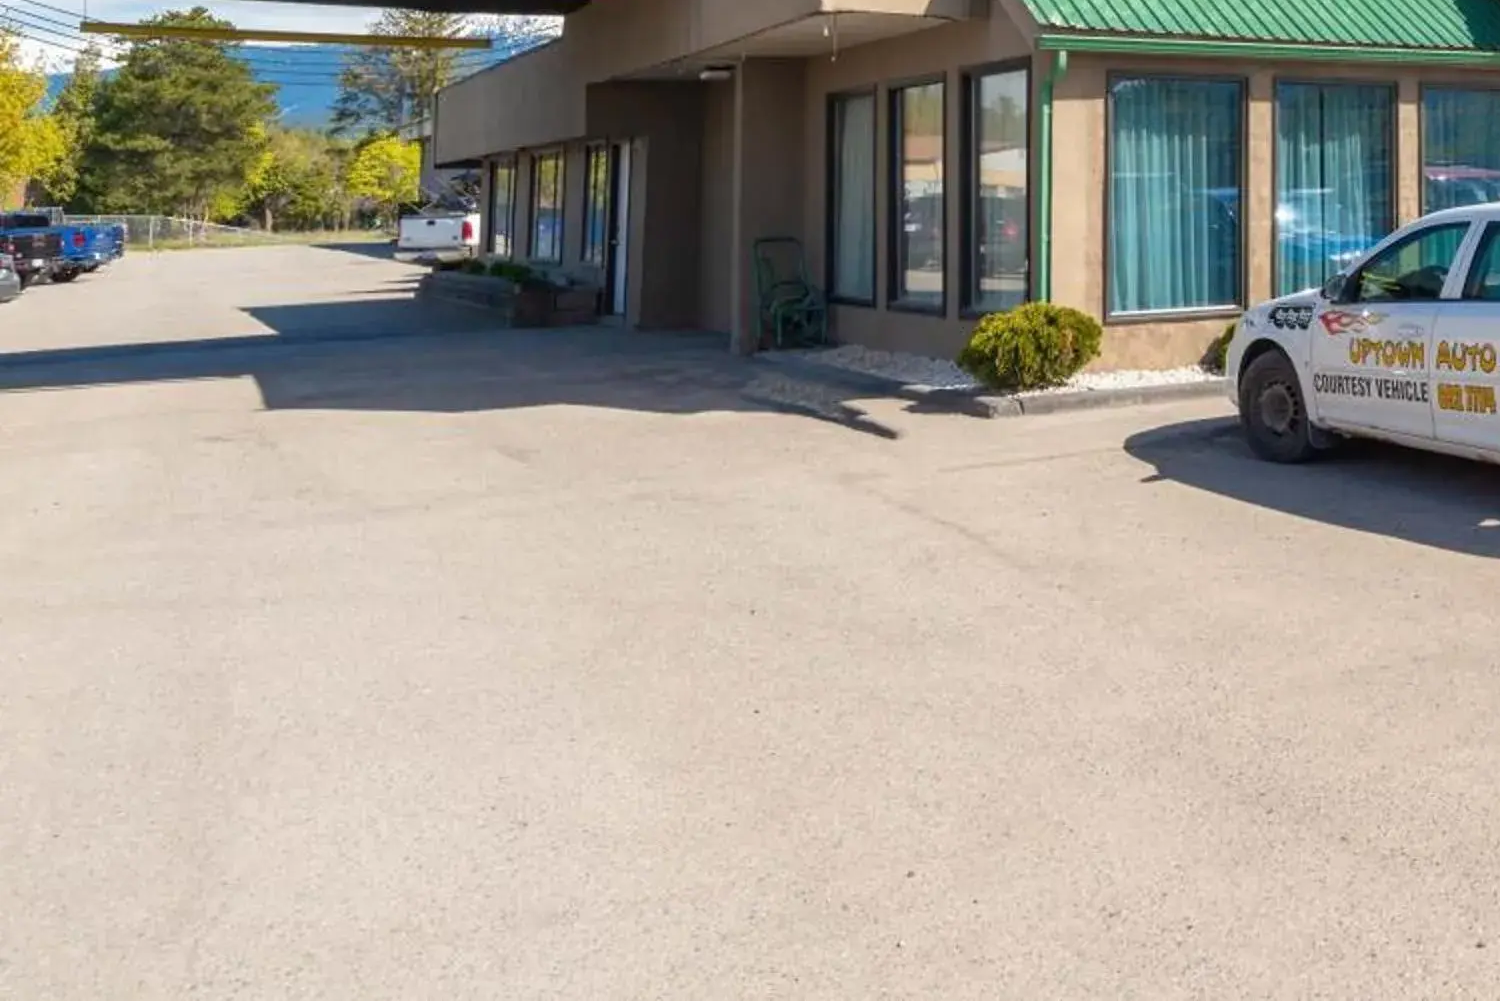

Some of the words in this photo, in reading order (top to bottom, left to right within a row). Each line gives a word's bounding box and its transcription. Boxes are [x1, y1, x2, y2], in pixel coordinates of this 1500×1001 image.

[1349, 337, 1425, 370] UPTOWN
[1435, 340, 1498, 373] AUTO
[1313, 373, 1373, 397] COURTESY
[1374, 378, 1429, 402] VEHICLE
